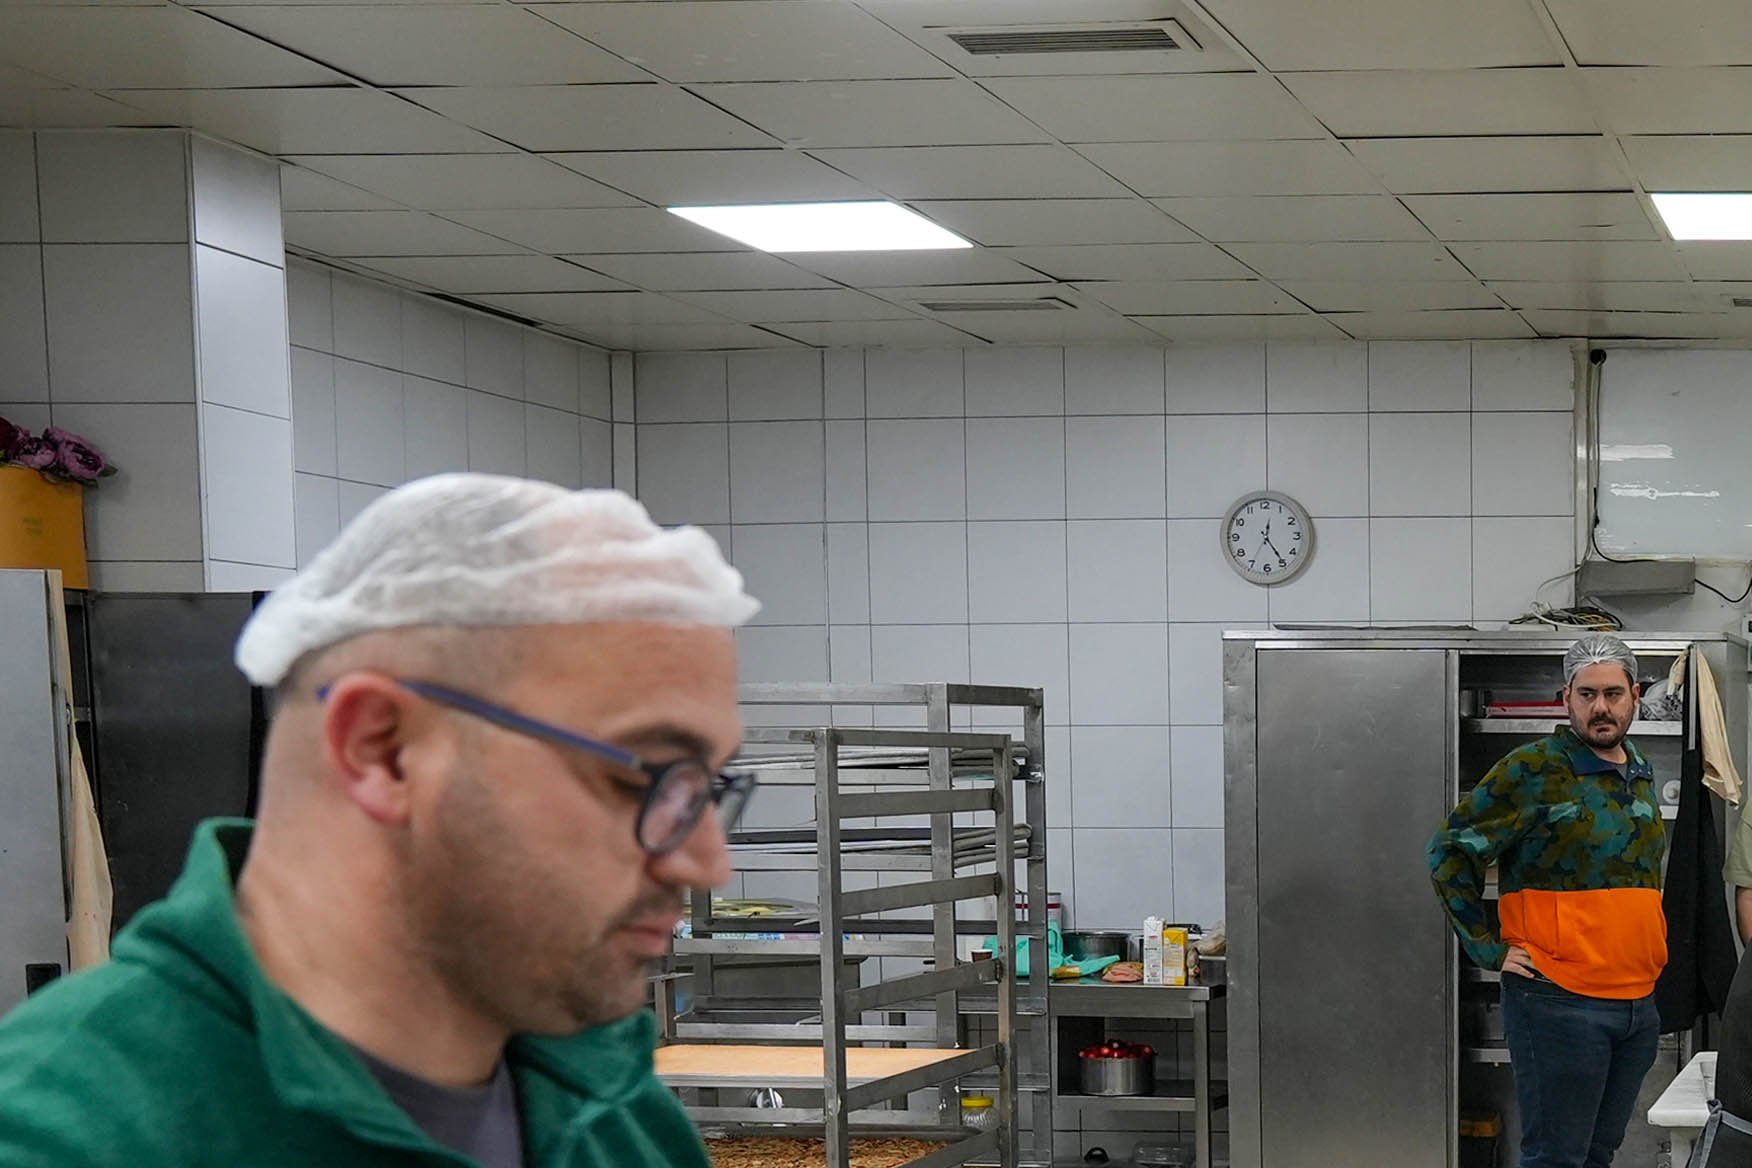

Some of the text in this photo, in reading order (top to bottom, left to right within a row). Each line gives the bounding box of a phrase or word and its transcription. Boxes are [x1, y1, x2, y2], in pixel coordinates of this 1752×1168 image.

[1246, 506, 1254, 514] 11
[1259, 501, 1270, 510] 12
[1278, 505, 1283, 514] 1
[1235, 518, 1245, 527] 10
[1287, 517, 1296, 526] 2
[1231, 533, 1240, 542] 9
[1292, 532, 1302, 541] 3
[1236, 548, 1246, 557] 8
[1288, 547, 1297, 556] 4
[1248, 559, 1256, 568] 7
[1263, 563, 1272, 573] 6
[1278, 559, 1287, 568] 5
